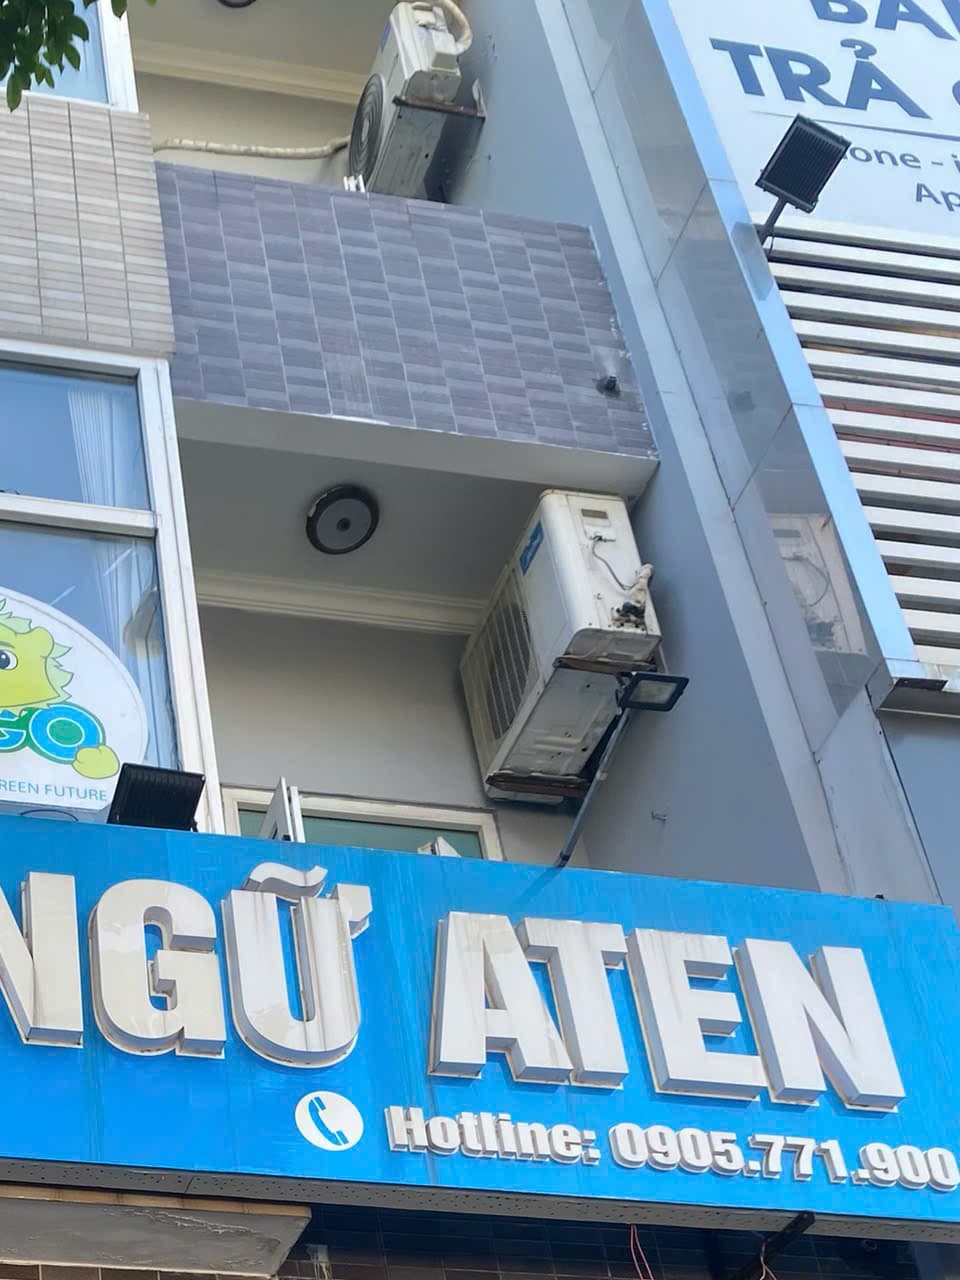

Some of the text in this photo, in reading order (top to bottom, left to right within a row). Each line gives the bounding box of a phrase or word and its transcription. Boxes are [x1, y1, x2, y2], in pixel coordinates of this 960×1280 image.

[708, 38, 933, 120] TRẢ
[44, 783, 108, 801] FUTURE
[428, 911, 907, 1114] ATEN
[384, 1105, 960, 1193] Hotline: 0905.771.900
